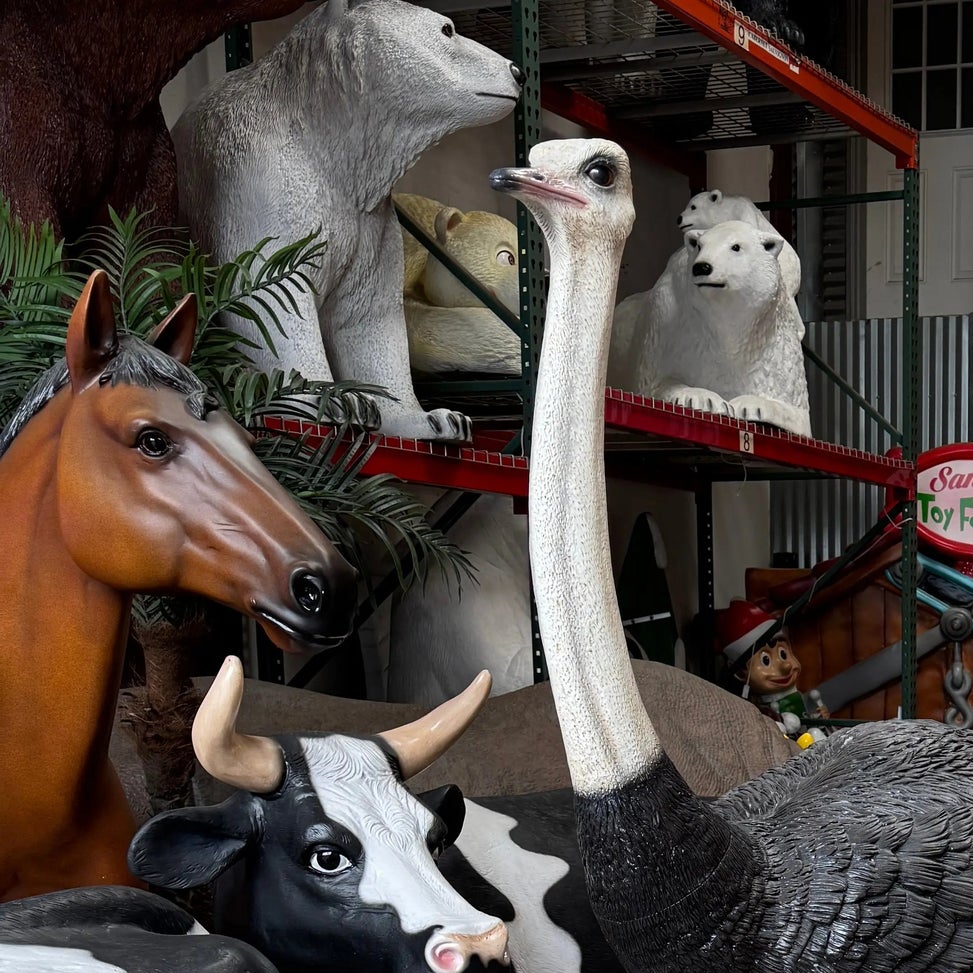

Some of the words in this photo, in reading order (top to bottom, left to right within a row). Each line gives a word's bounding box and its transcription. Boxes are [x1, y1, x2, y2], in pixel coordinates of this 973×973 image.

[738, 25, 745, 46] 9
[743, 432, 750, 451] 8
[917, 492, 954, 532] Toy
